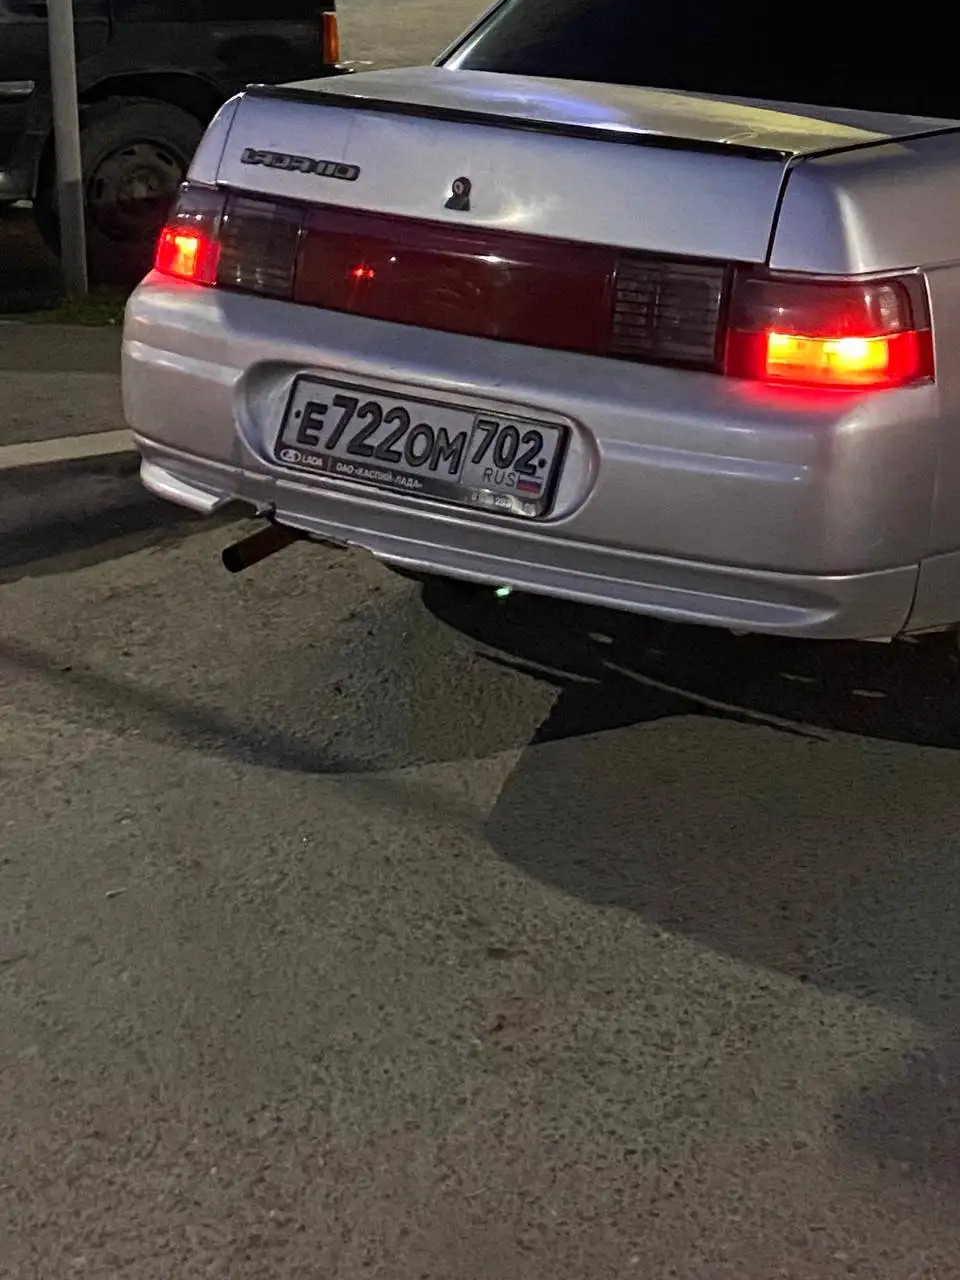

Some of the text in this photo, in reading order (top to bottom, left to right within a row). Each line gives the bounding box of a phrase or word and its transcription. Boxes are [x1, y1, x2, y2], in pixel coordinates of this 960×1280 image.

[472, 419, 546, 477] 702
[301, 455, 324, 467] LADA
[482, 468, 517, 487] RUS
